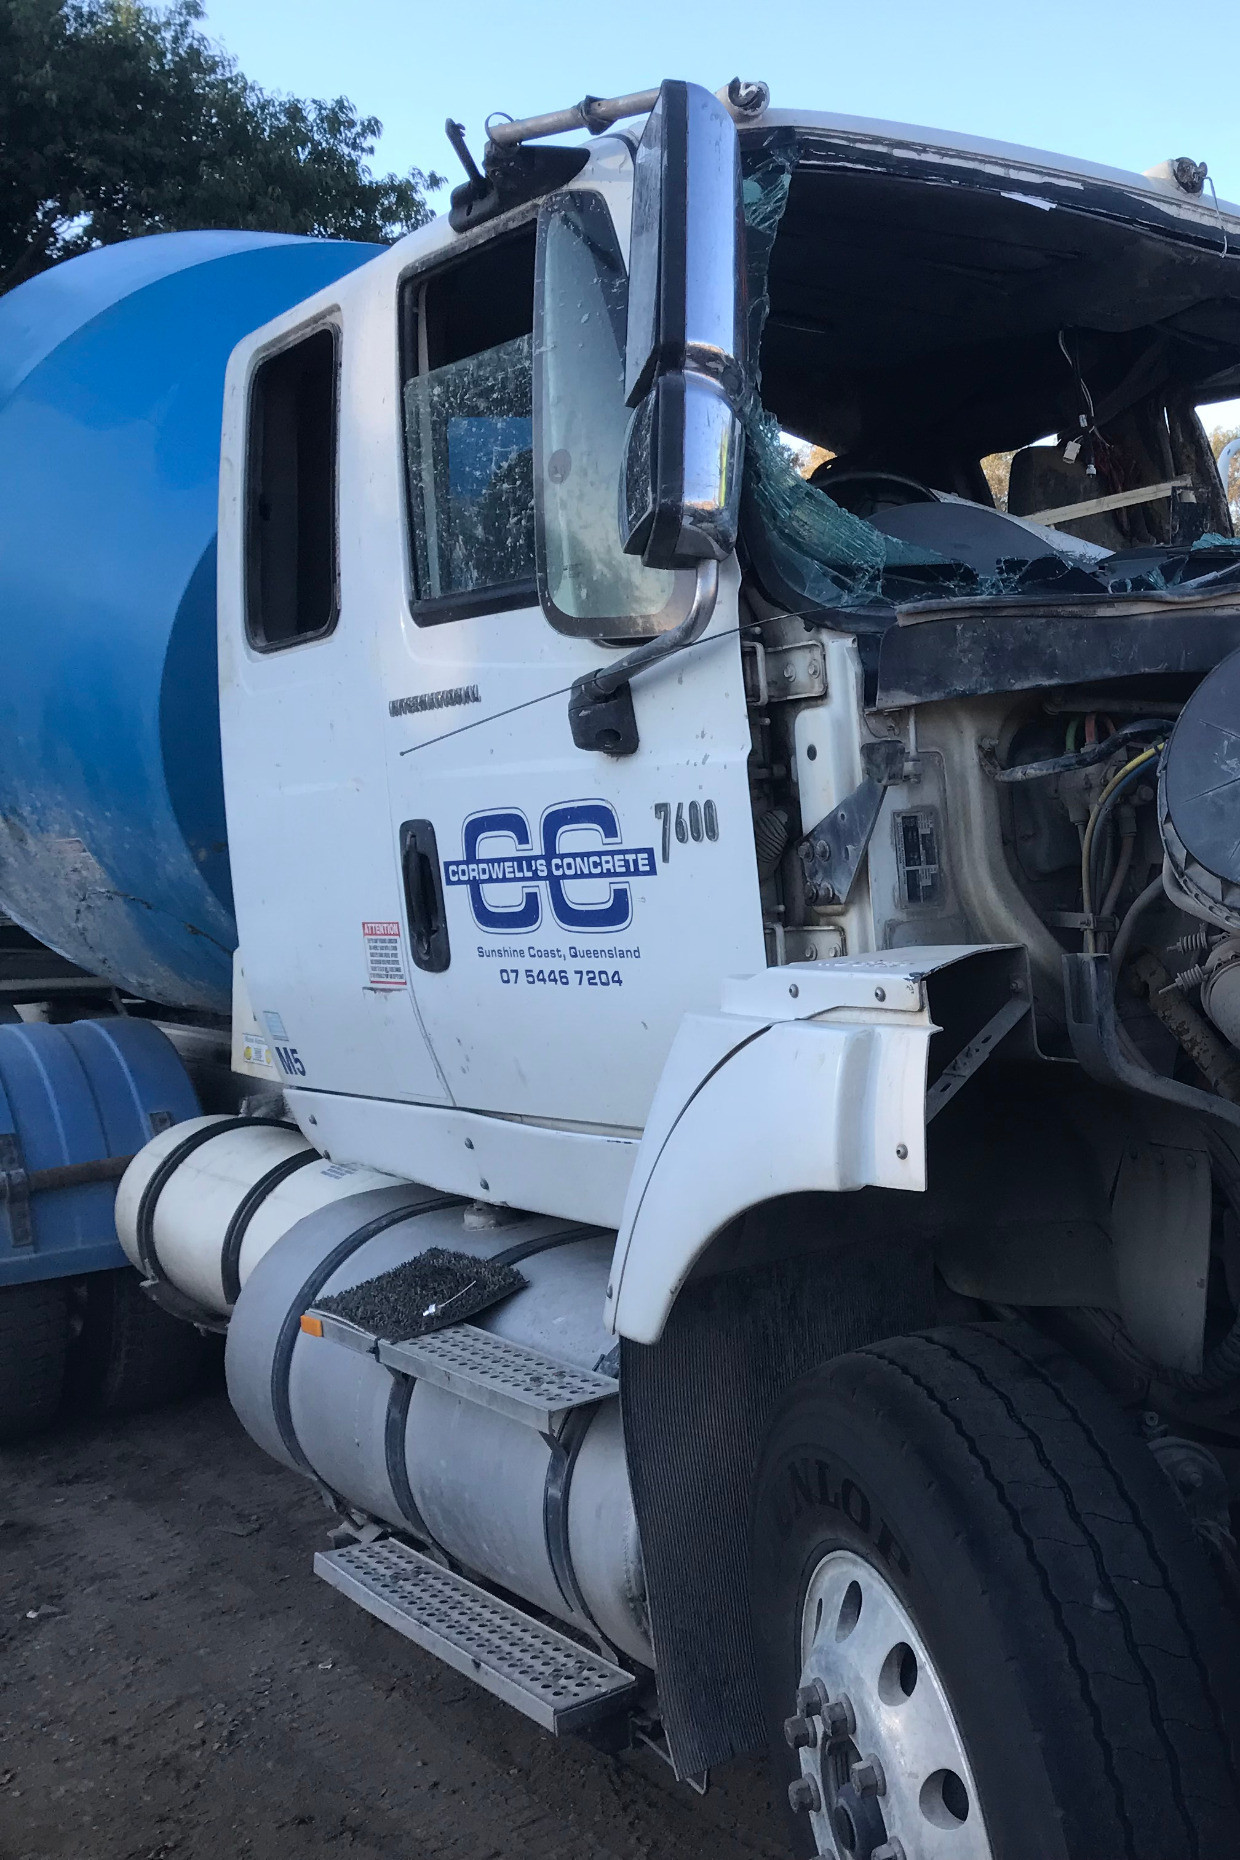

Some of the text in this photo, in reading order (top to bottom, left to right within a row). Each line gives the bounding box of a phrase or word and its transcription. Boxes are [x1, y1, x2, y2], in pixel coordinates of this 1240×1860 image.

[654, 799, 720, 864] 7600
[448, 852, 651, 882] CORDWELL'S CONCRETE
[364, 923, 399, 935] ATTENTION
[476, 945, 641, 961] Sunshine Coast, Queensland
[499, 968, 623, 988] 07 5446 7204
[275, 1046, 306, 1076] M5
